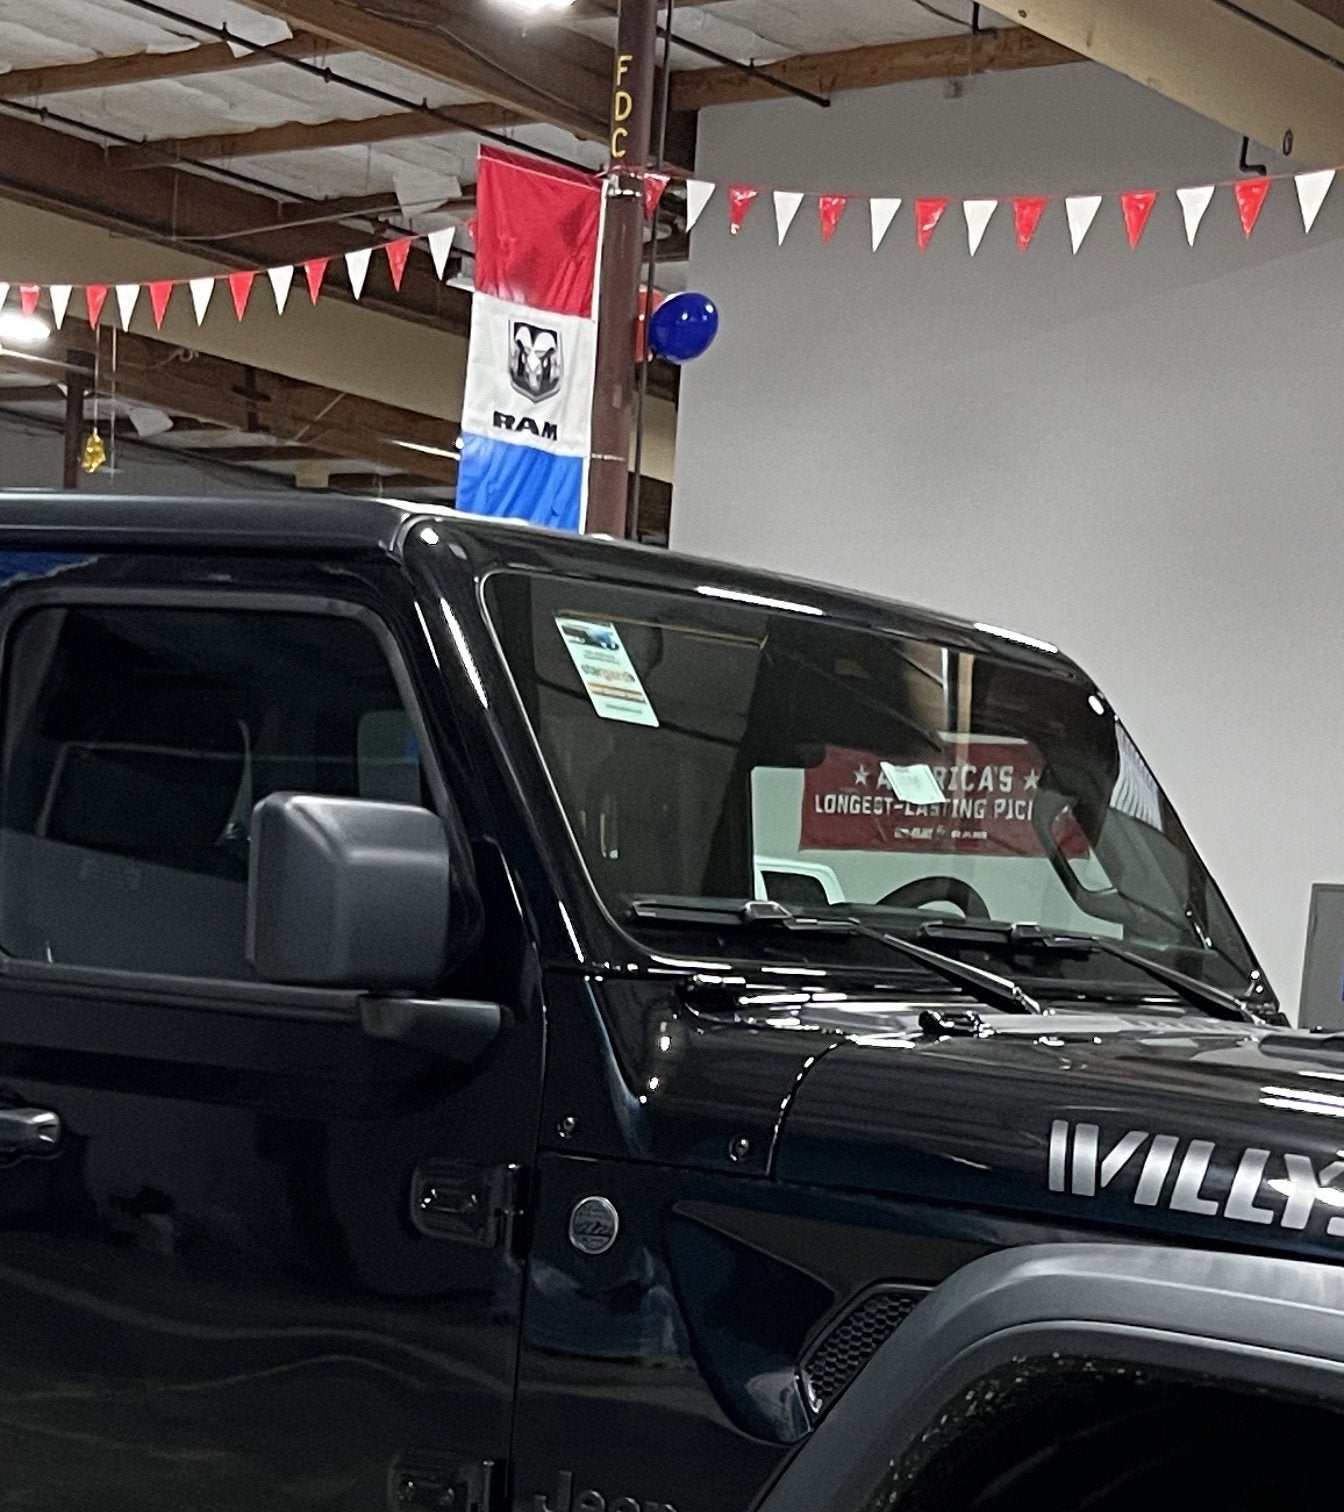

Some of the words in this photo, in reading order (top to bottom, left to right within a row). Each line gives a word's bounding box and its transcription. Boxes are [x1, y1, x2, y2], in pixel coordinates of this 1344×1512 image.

[611, 54, 634, 159] FDC
[492, 411, 559, 441] RAM
[876, 765, 1014, 792] ARICA'S
[814, 795, 985, 819] LONGEST-LASTING
